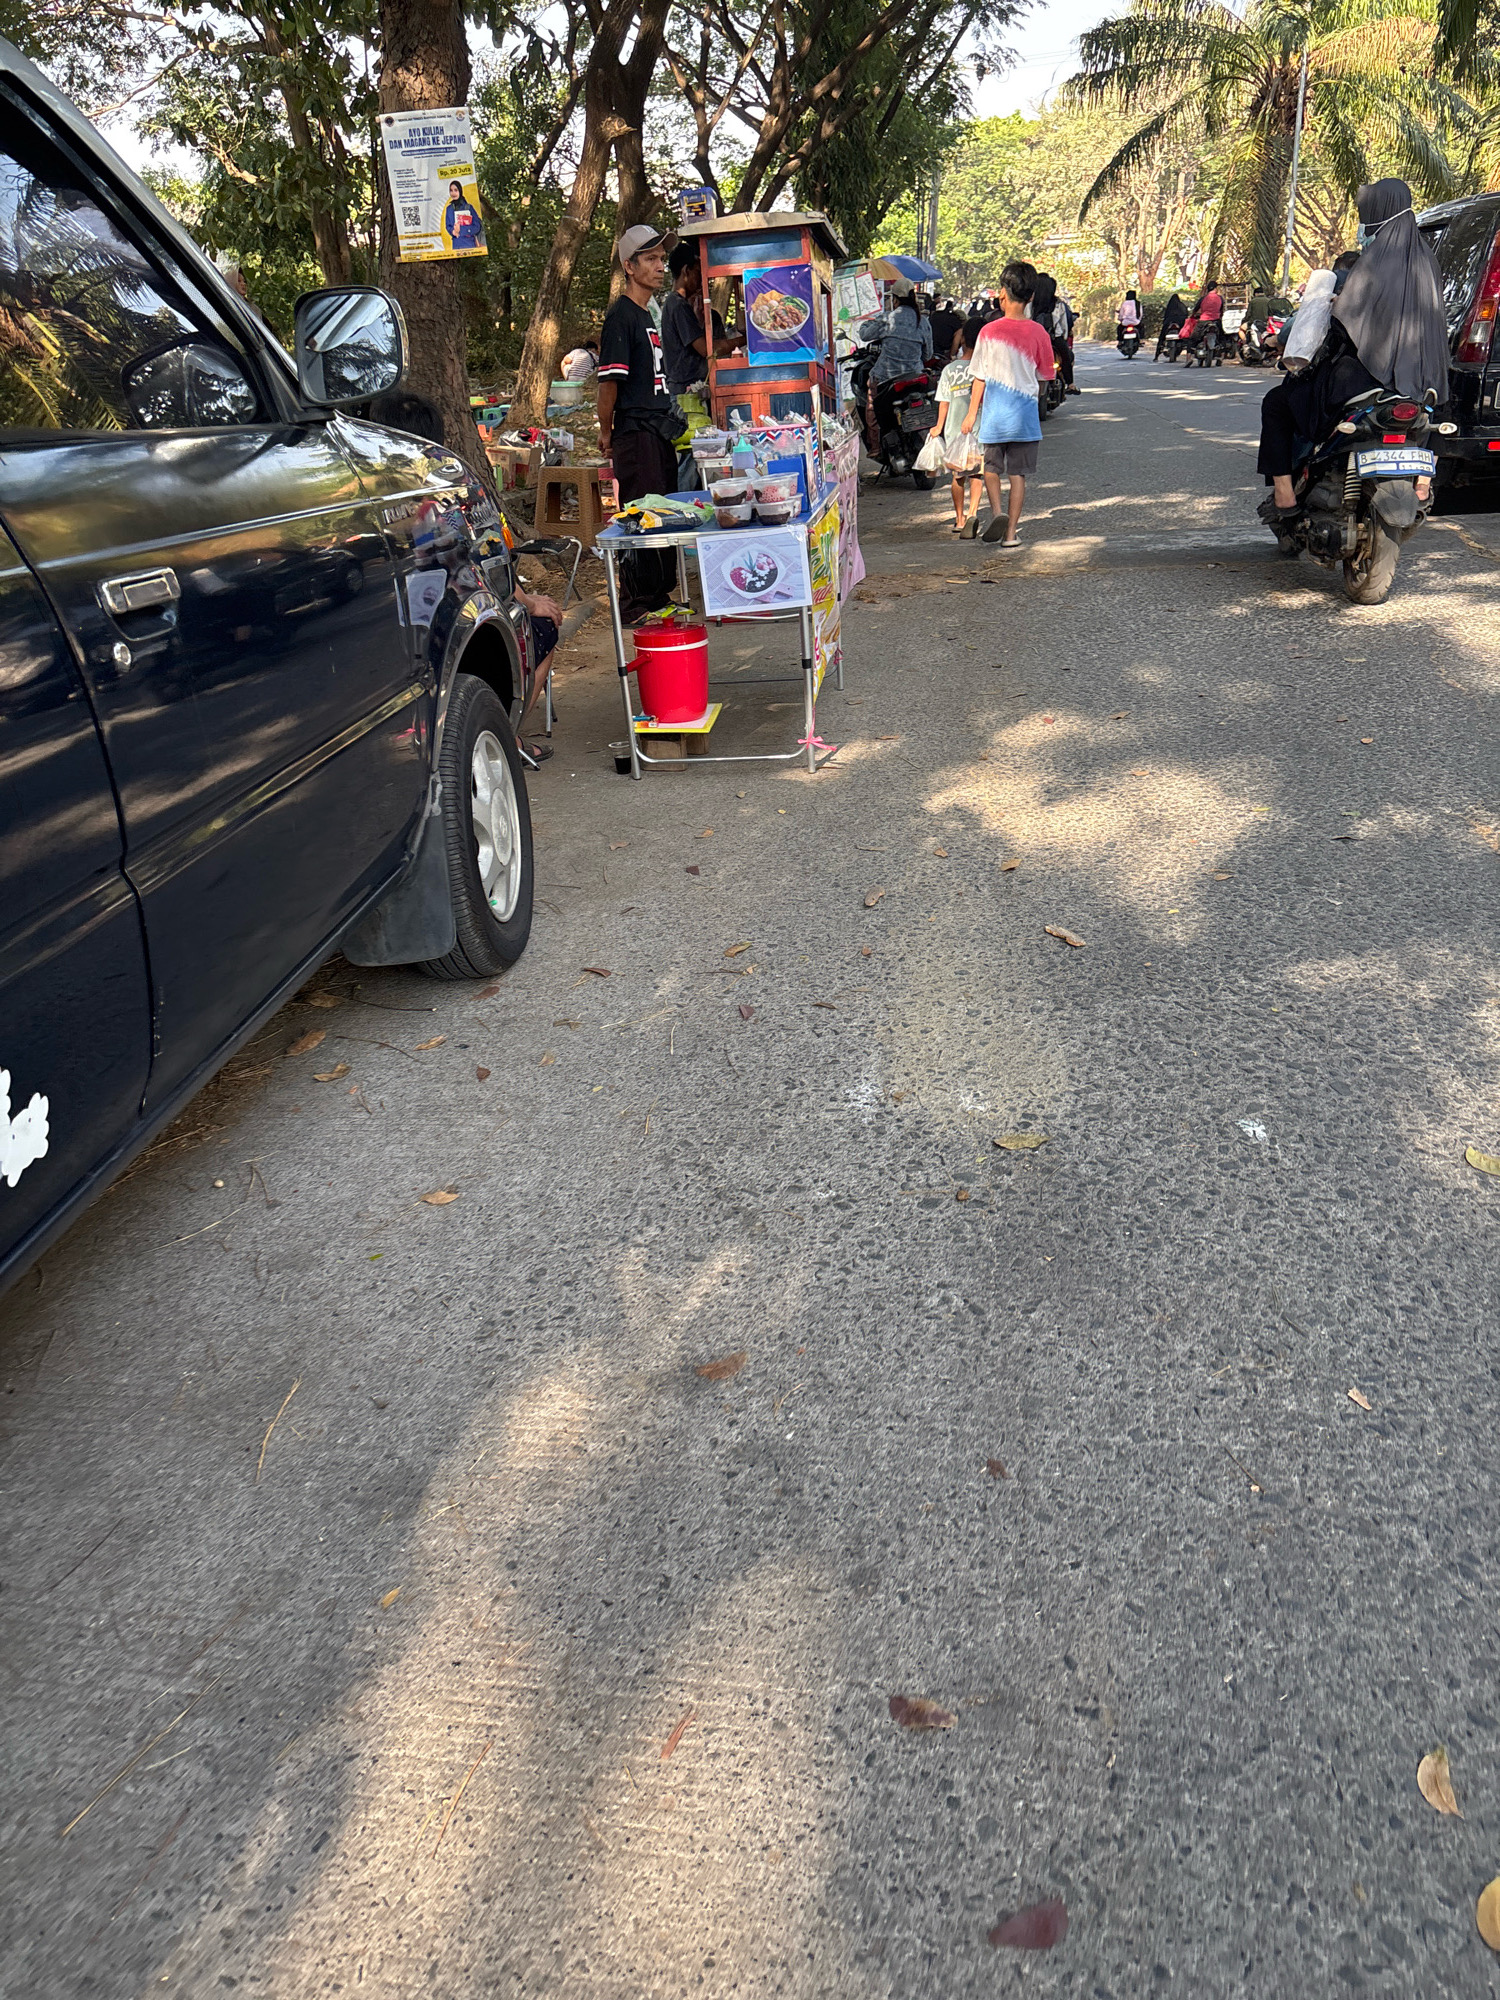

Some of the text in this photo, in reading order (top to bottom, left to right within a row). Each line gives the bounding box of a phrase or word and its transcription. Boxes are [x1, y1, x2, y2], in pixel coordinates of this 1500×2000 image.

[408, 126, 444, 137] AYO KULIAH
[389, 135, 466, 149] DAN MAGANG KE JEPANG
[1361, 455, 1368, 464] B
